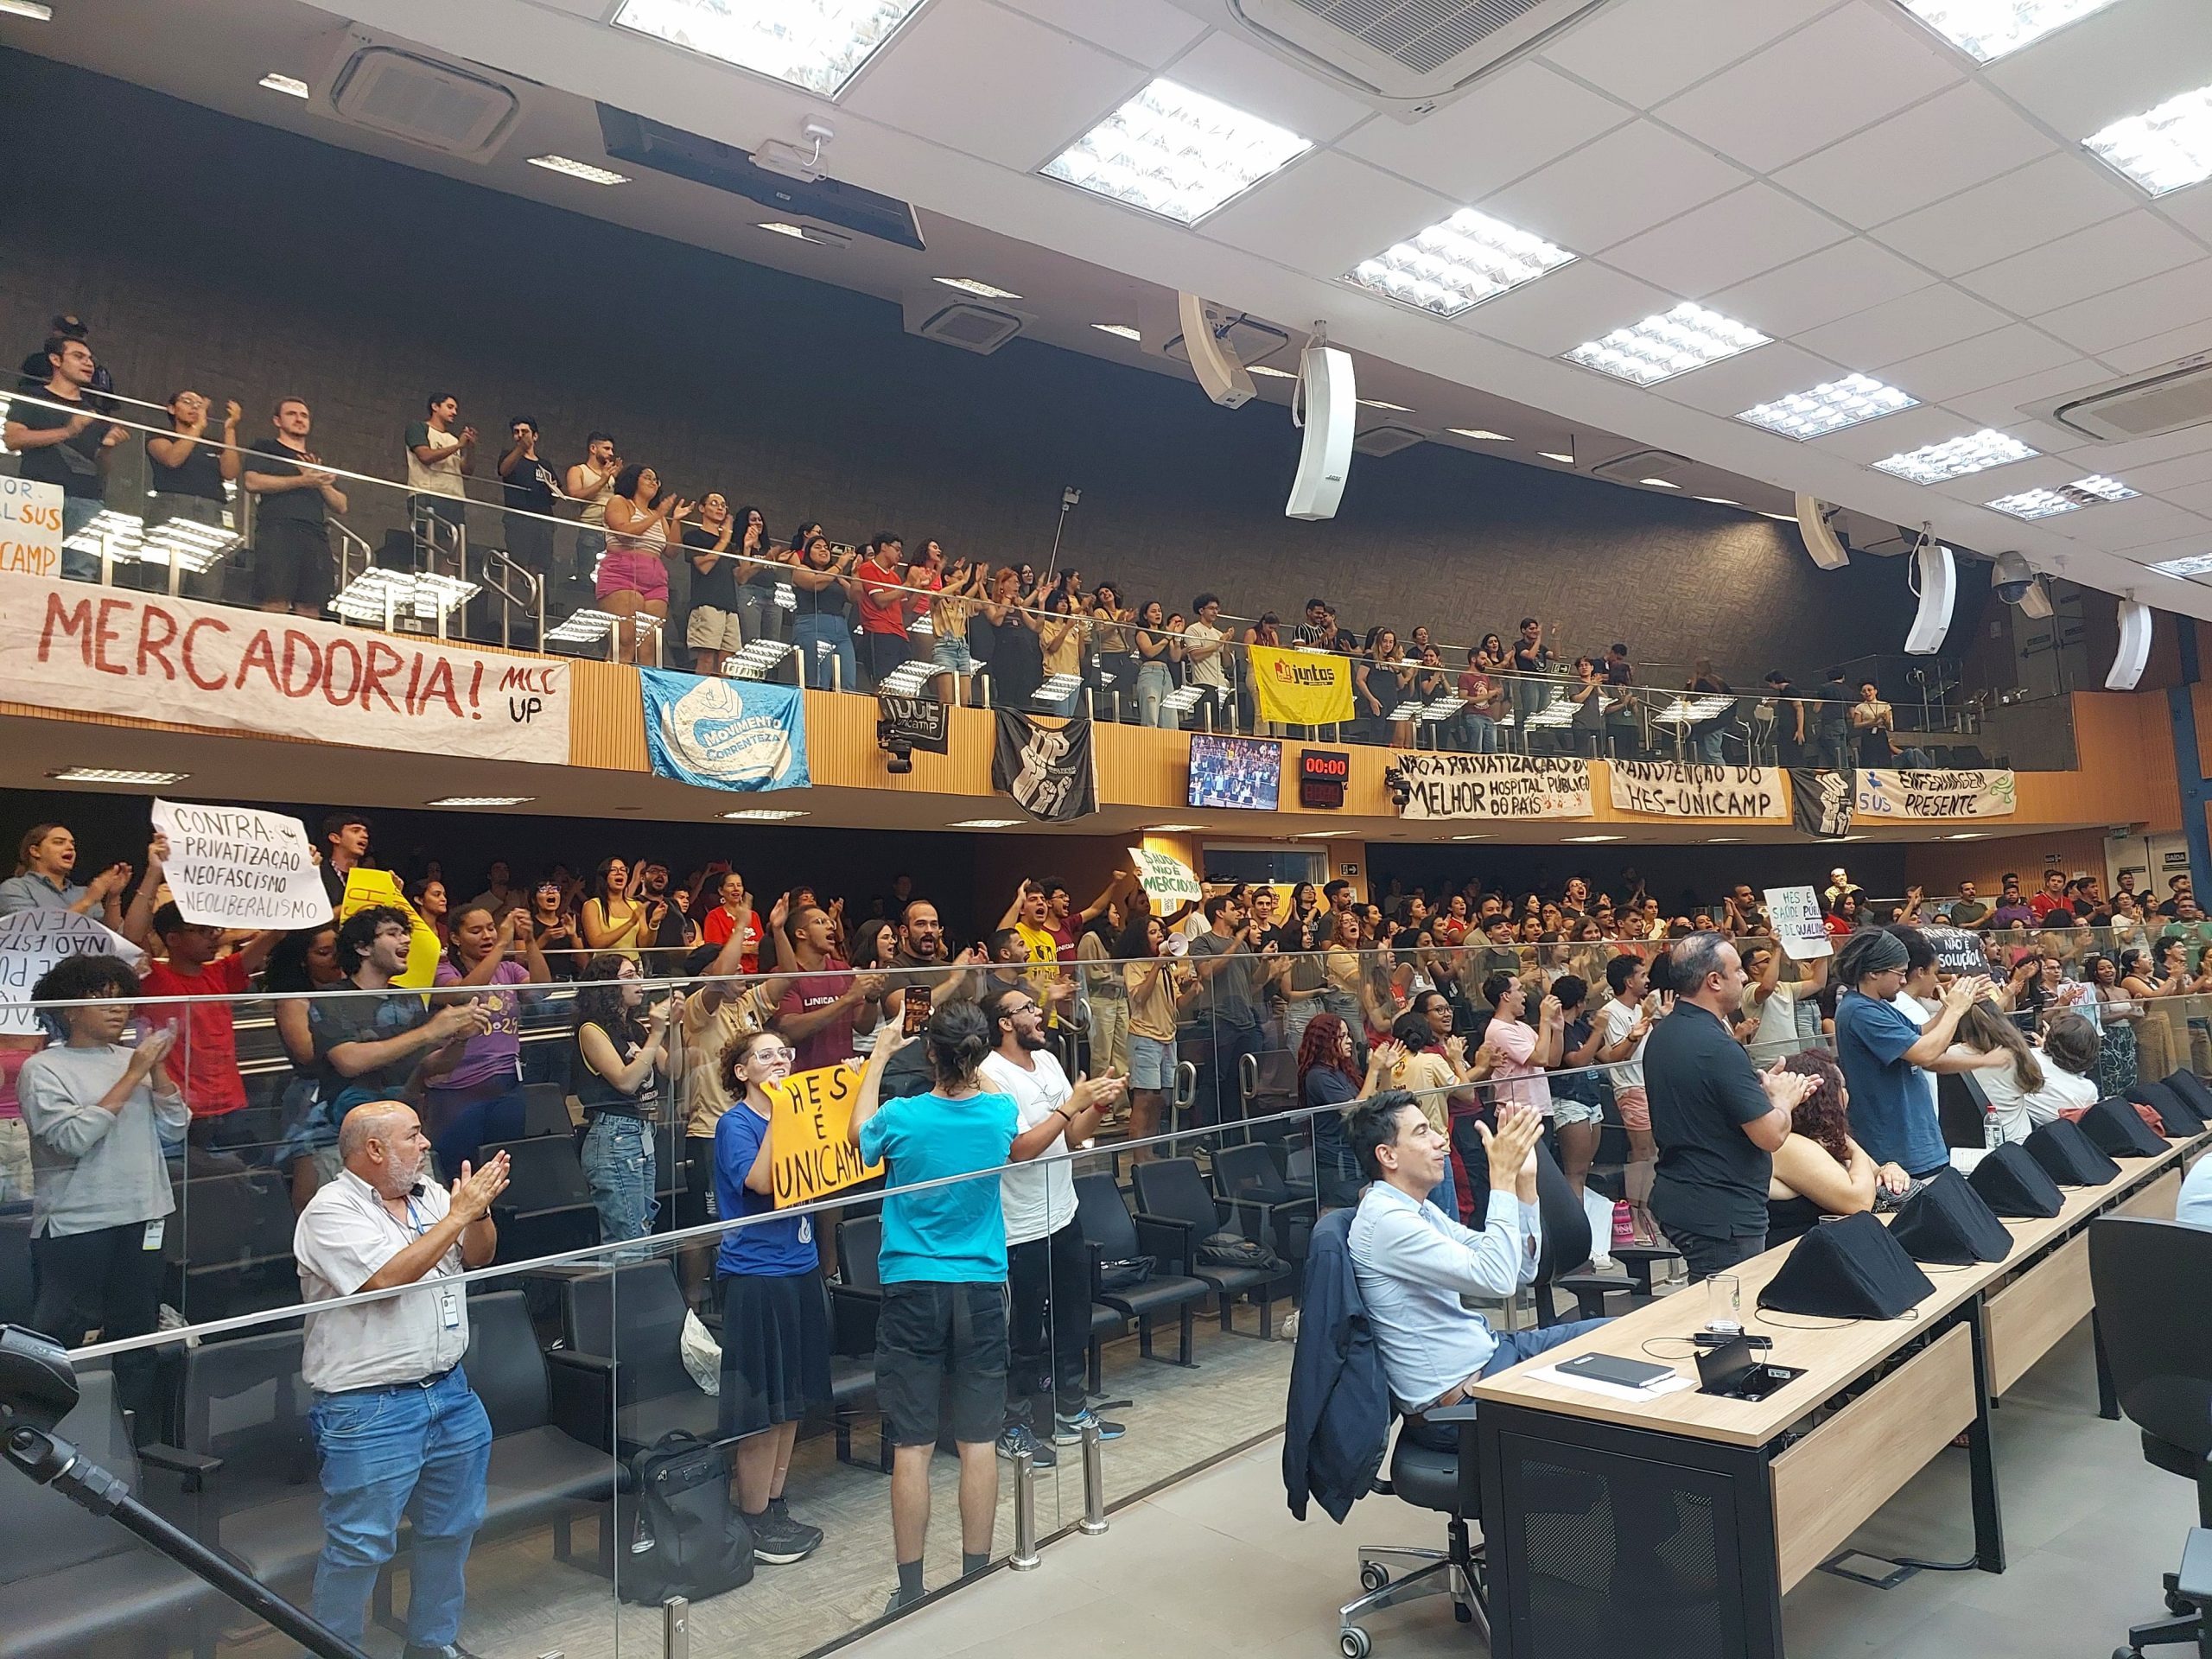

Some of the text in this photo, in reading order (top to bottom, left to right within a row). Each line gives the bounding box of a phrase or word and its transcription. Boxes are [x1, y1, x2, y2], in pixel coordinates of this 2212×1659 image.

[20, 504, 61, 531] SUS
[37, 591, 484, 720] MERCADORIA!
[1292, 664, 1335, 684] juntos
[508, 696, 542, 723] UP
[702, 715, 782, 747] MOVIMENTO
[897, 718, 938, 734] unicamp
[706, 734, 781, 761] CORRENTEZA
[1027, 723, 1071, 766] UP
[1306, 757, 1346, 776] 00:00
[1737, 766, 1762, 785] DO
[1490, 773, 1590, 796] HOSPITAL PÚBLICO
[1898, 770, 1987, 792] ENFERMAGEM
[1409, 780, 1485, 817] MELHOR
[1491, 793, 1543, 816] DO PAÍS
[1627, 783, 1770, 817] HES-UNICAMP
[1859, 792, 1891, 813] SUS
[1905, 793, 1978, 817] PRESENTE
[175, 808, 275, 842] CONTRA:
[1783, 891, 1801, 904] HES
[1944, 937, 1970, 950] NÃO É
[1938, 949, 1982, 970] SOLUÇÃO!
[785, 1067, 848, 1115] HES
[814, 1104, 828, 1141] É
[705, 1191, 716, 1215] NIKE
